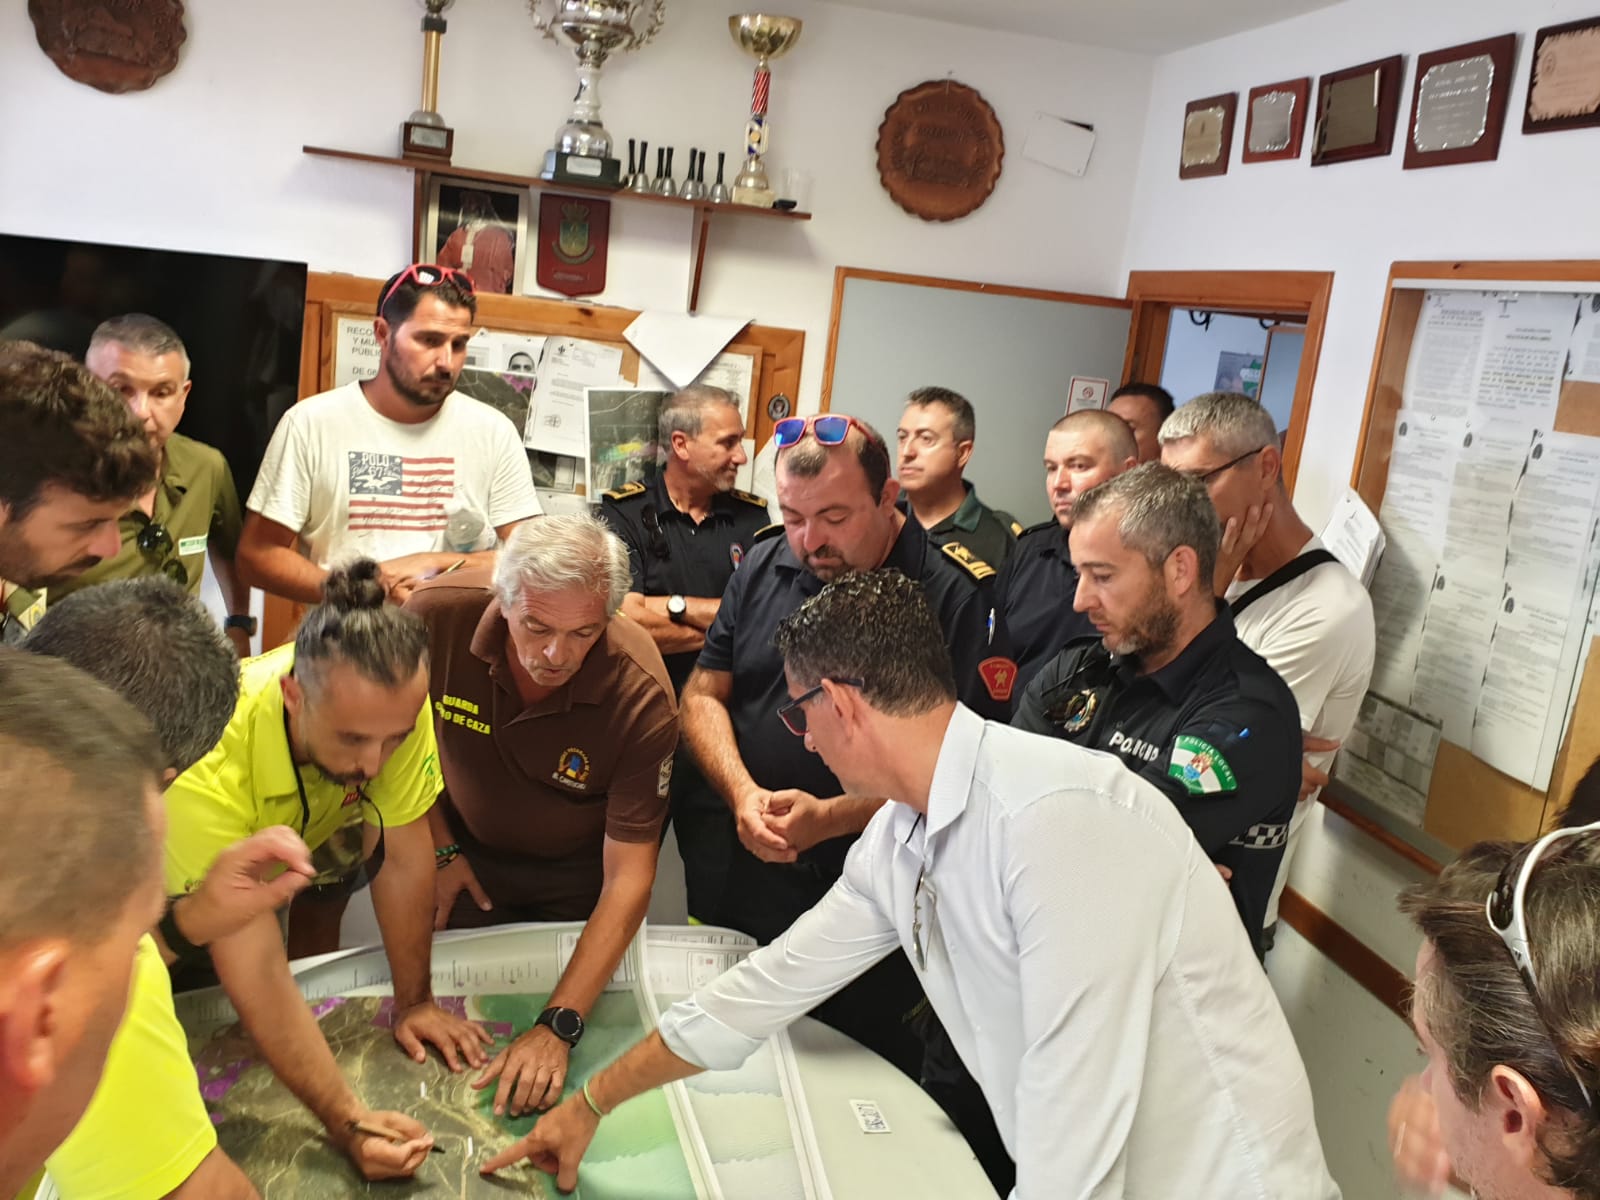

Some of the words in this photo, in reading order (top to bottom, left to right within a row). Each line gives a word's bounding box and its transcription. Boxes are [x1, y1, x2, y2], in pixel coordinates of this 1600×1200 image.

[346, 326, 374, 336] RECO
[352, 336, 359, 345] Y
[352, 366, 365, 376] DE
[361, 452, 389, 467] POLO
[368, 466, 384, 478] 67
[442, 694, 479, 715] GUARDA
[452, 713, 466, 726] DE
[465, 718, 491, 735] CAZA
